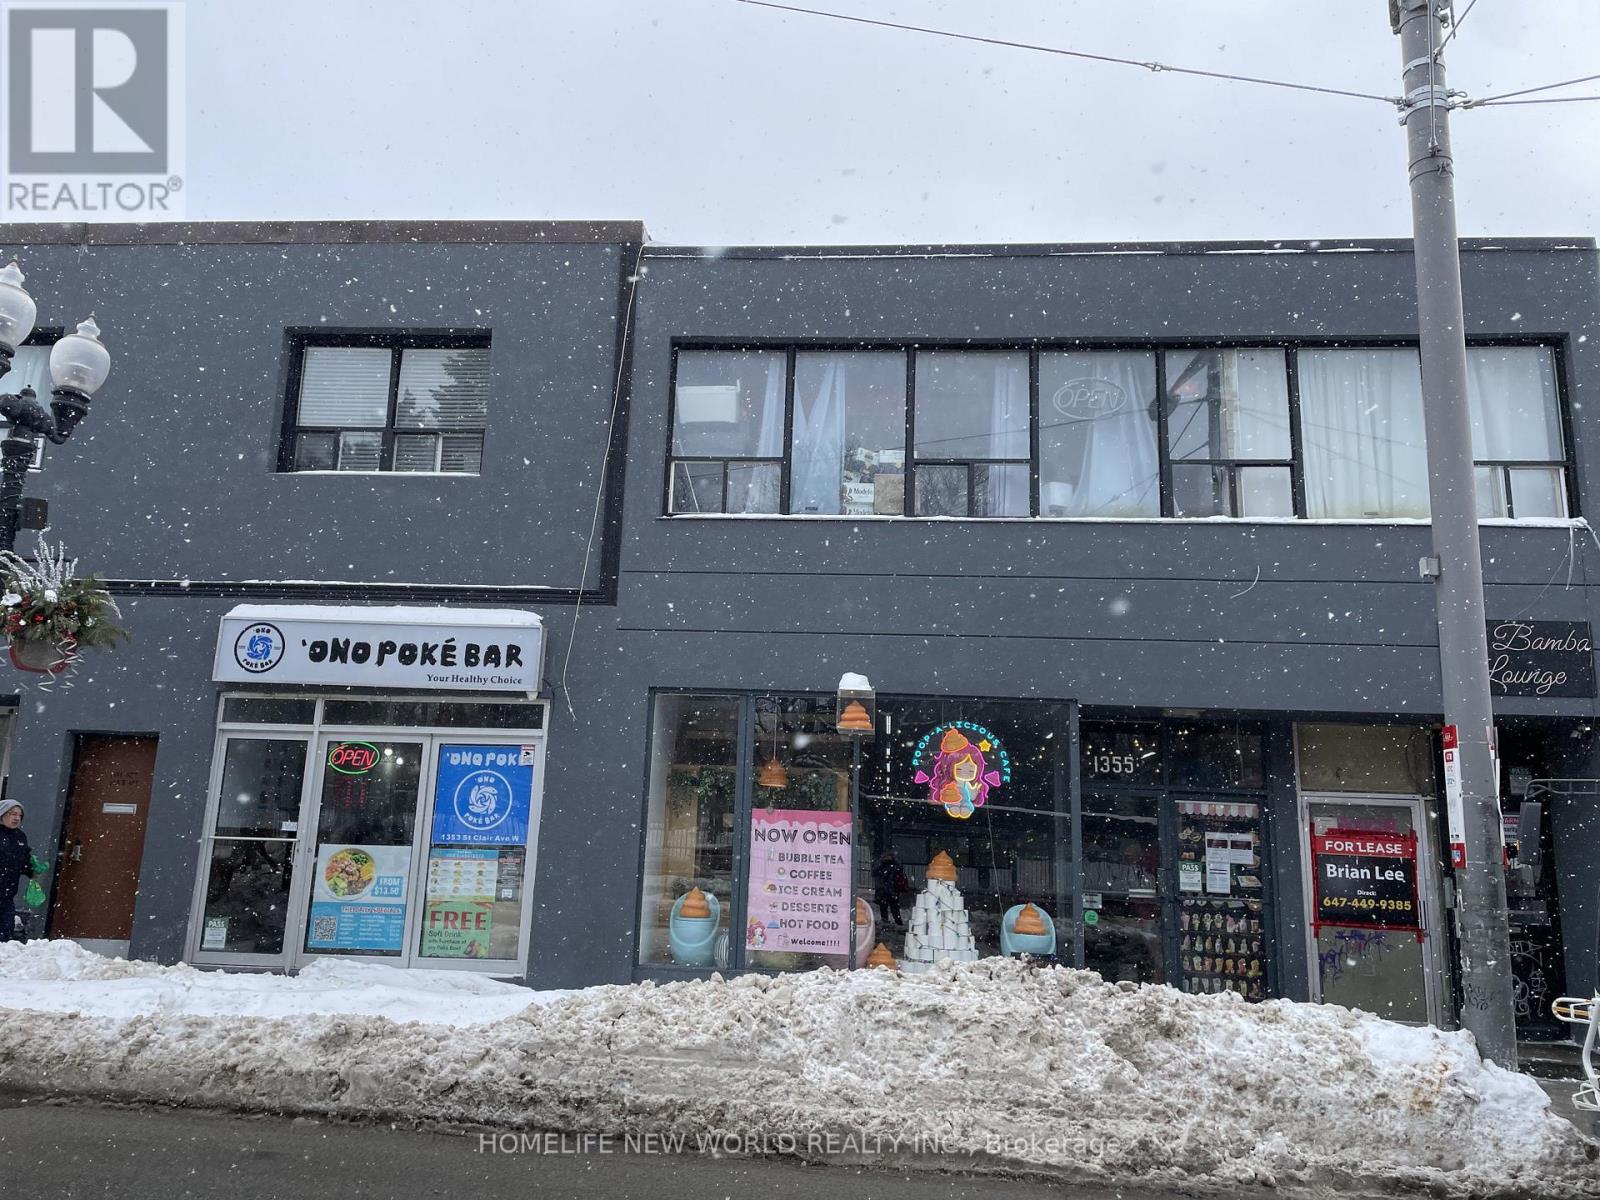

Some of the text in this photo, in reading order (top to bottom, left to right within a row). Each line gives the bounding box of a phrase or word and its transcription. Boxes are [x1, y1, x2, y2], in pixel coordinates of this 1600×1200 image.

[1492, 623, 1592, 651] Bamba
[375, 637, 457, 667] POKÉ
[464, 643, 523, 668] BAR
[427, 674, 523, 685] Your Healthy Choice
[1489, 654, 1567, 694] Lounge
[331, 749, 376, 767] OPEN
[485, 752, 521, 767] POK
[1094, 756, 1134, 773] 1355
[1000, 751, 1011, 783] CAFE
[754, 828, 851, 845] NOW OPEN
[1325, 840, 1403, 854] FOR LEASE
[778, 852, 845, 865] BUBBLE TEA
[789, 869, 832, 880] COFFEE
[1182, 864, 1199, 872] PASS
[1326, 863, 1404, 881] Brian Lee
[380, 877, 400, 885] FROM
[779, 885, 842, 897] ICE CREAM
[781, 902, 838, 913] DESSERTS
[1323, 896, 1412, 911] 647-449-9385
[208, 919, 225, 928] PASS
[429, 911, 488, 930] FREE
[780, 918, 839, 930] HOT FOOD
[429, 930, 442, 938] Soft
[790, 937, 840, 947] Welcome!!!!
